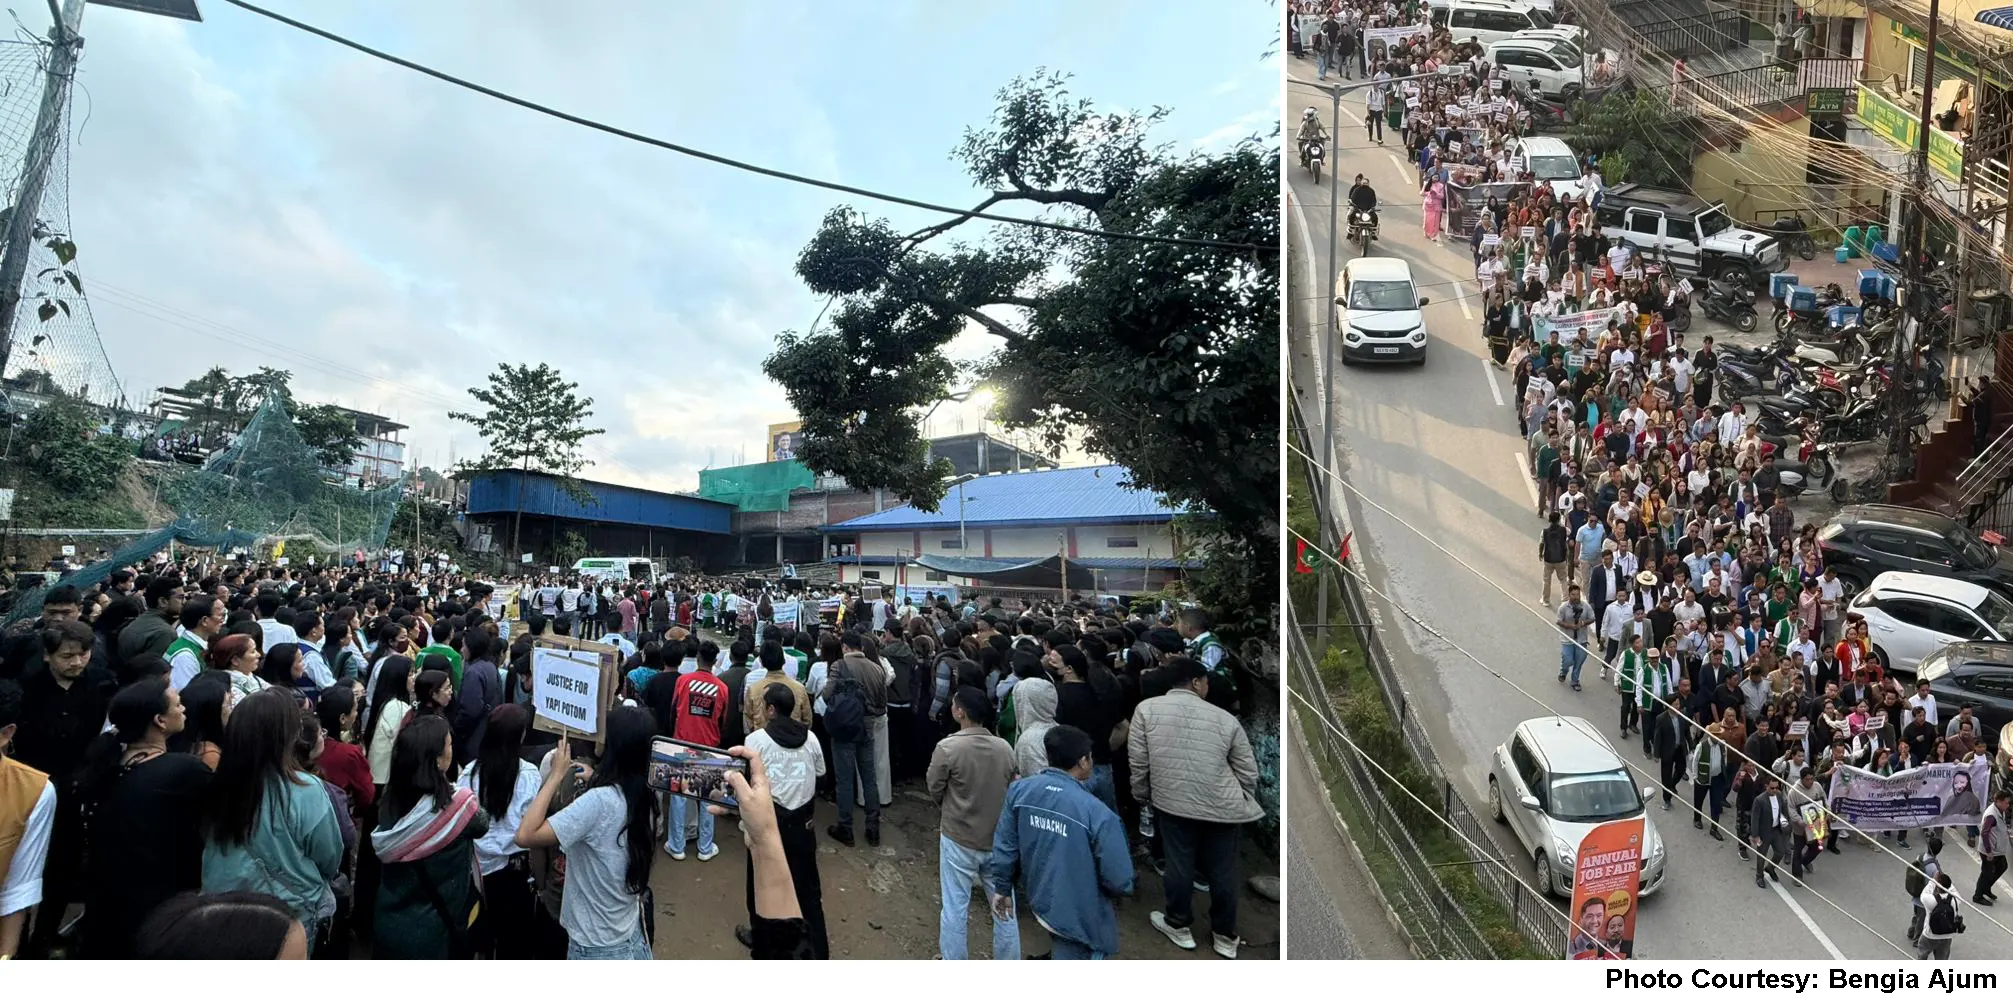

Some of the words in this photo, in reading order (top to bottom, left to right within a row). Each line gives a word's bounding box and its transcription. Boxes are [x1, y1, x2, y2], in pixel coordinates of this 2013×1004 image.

[546, 672, 574, 691] JUSTICE
[574, 680, 588, 696] FOR
[545, 696, 561, 713] YAPI
[561, 701, 587, 721] POTOM
[1926, 769, 1951, 779] MARCH
[1581, 848, 1638, 869] ANNUAL
[1579, 866, 1605, 885] JOB
[1605, 861, 1637, 877] FAIR
